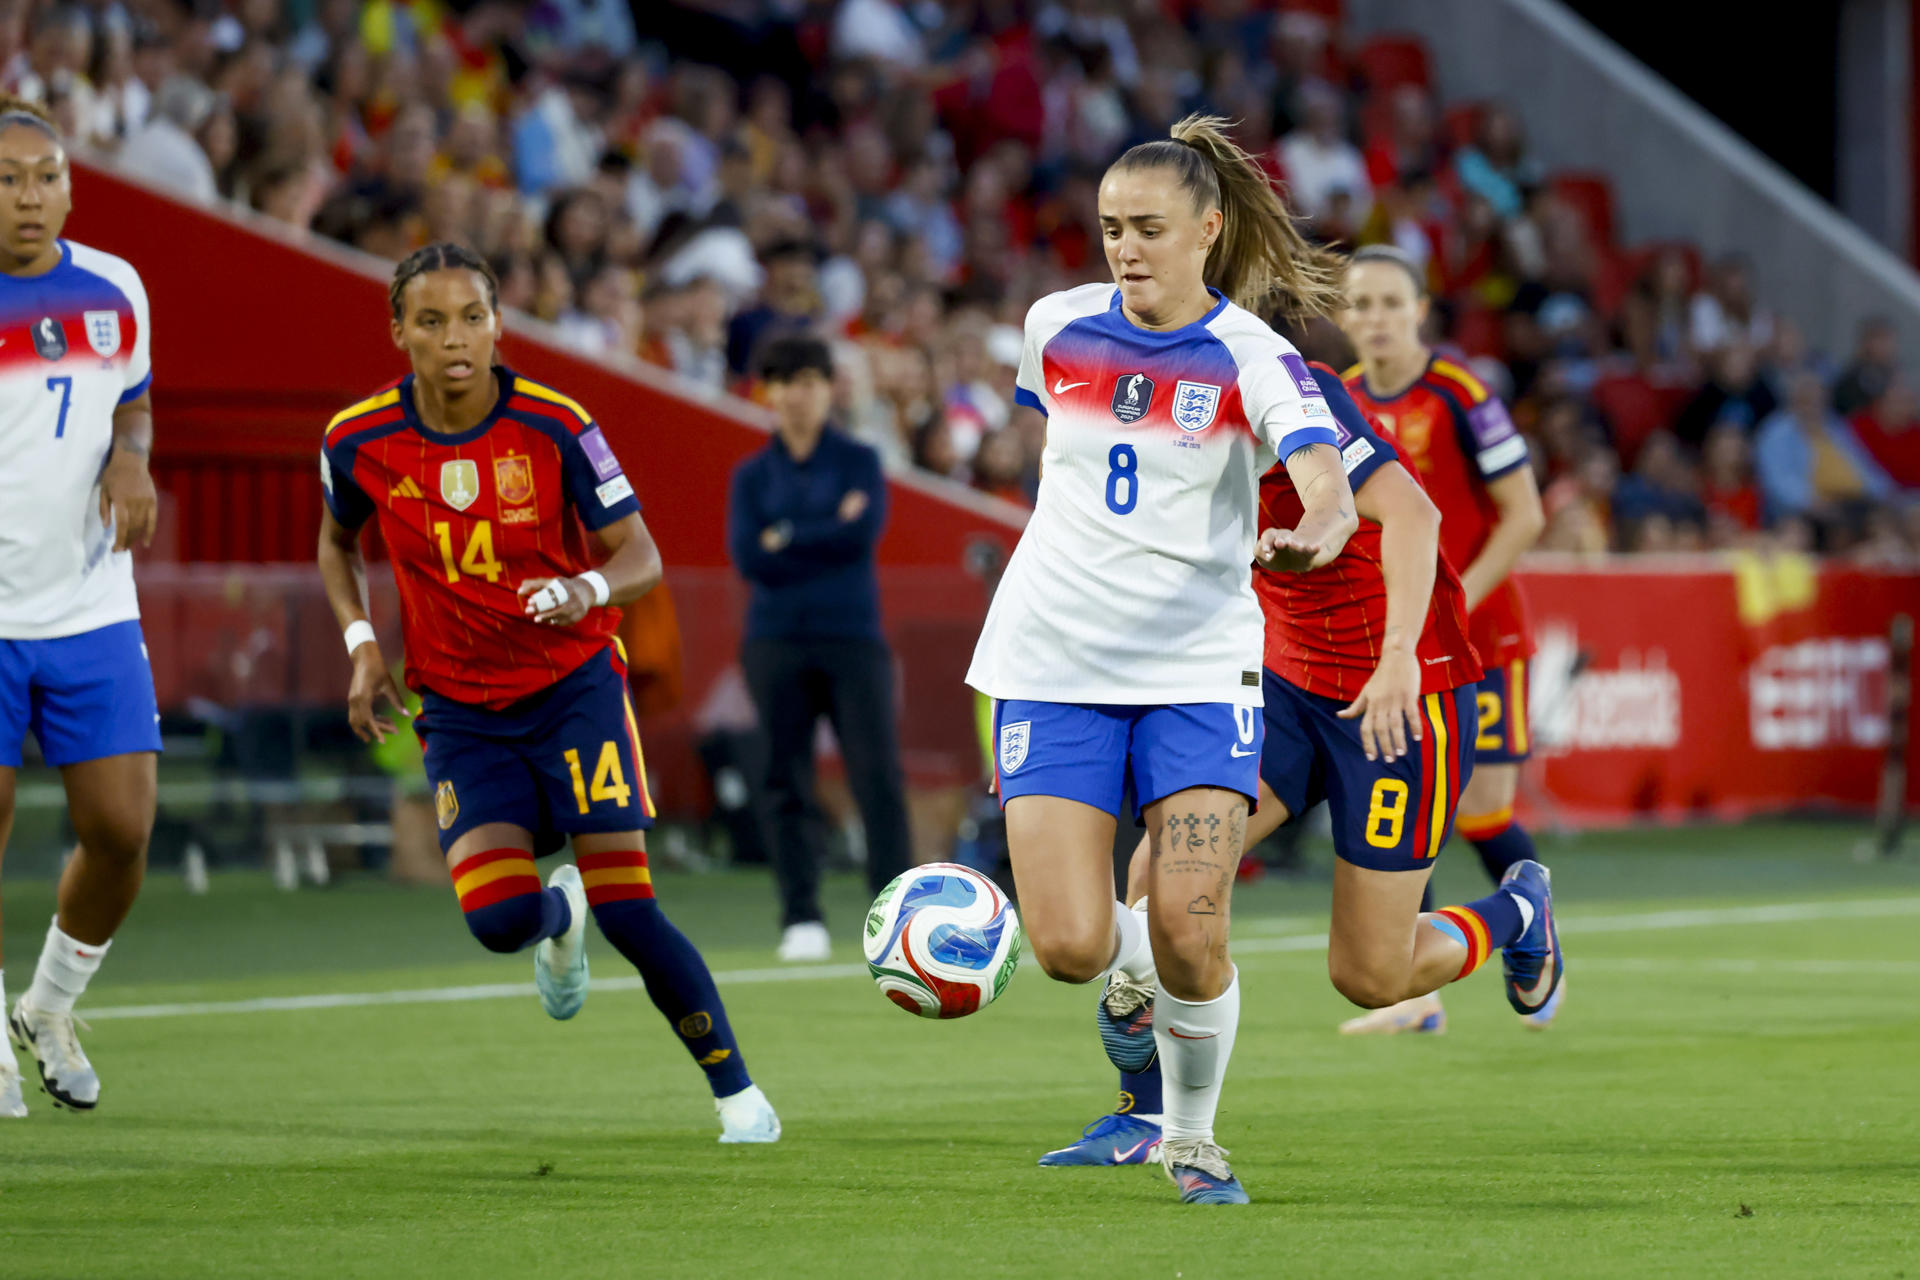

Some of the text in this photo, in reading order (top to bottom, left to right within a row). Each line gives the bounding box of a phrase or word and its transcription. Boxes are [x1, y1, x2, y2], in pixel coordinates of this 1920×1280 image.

[47, 376, 72, 438] 7
[1106, 444, 1138, 515] 8
[434, 520, 502, 584] 14
[563, 740, 631, 815] 14
[1365, 777, 1409, 849] 8
